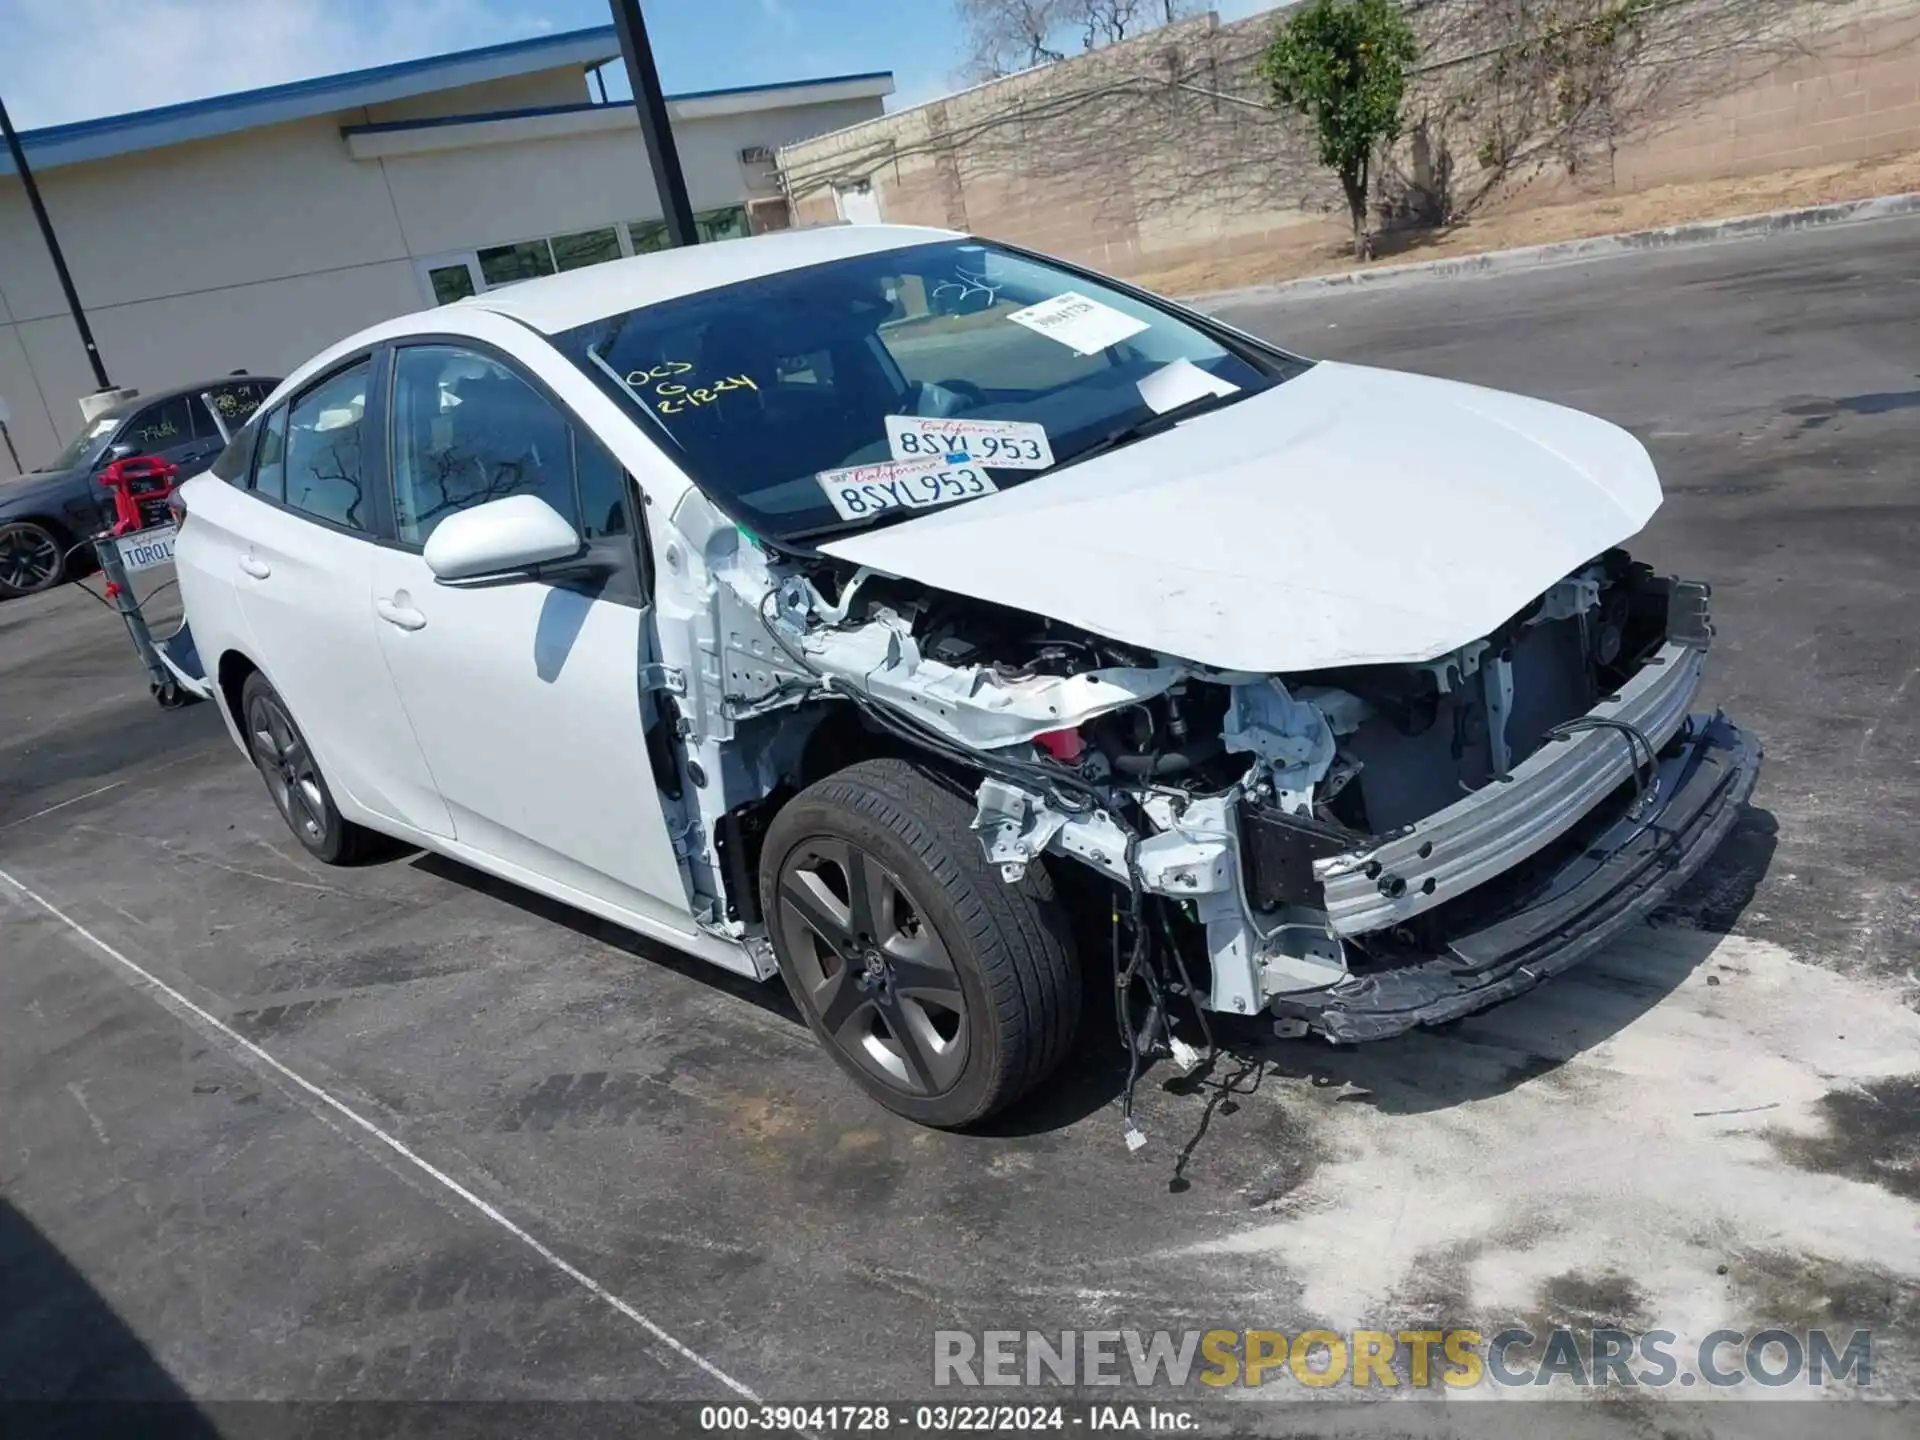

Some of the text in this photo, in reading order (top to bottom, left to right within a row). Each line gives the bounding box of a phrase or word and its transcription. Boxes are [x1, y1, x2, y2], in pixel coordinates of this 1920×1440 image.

[920, 420, 1007, 436] California
[901, 432, 1041, 460] 8SYL953
[852, 462, 939, 483] California
[840, 469, 985, 513] 8SYL953
